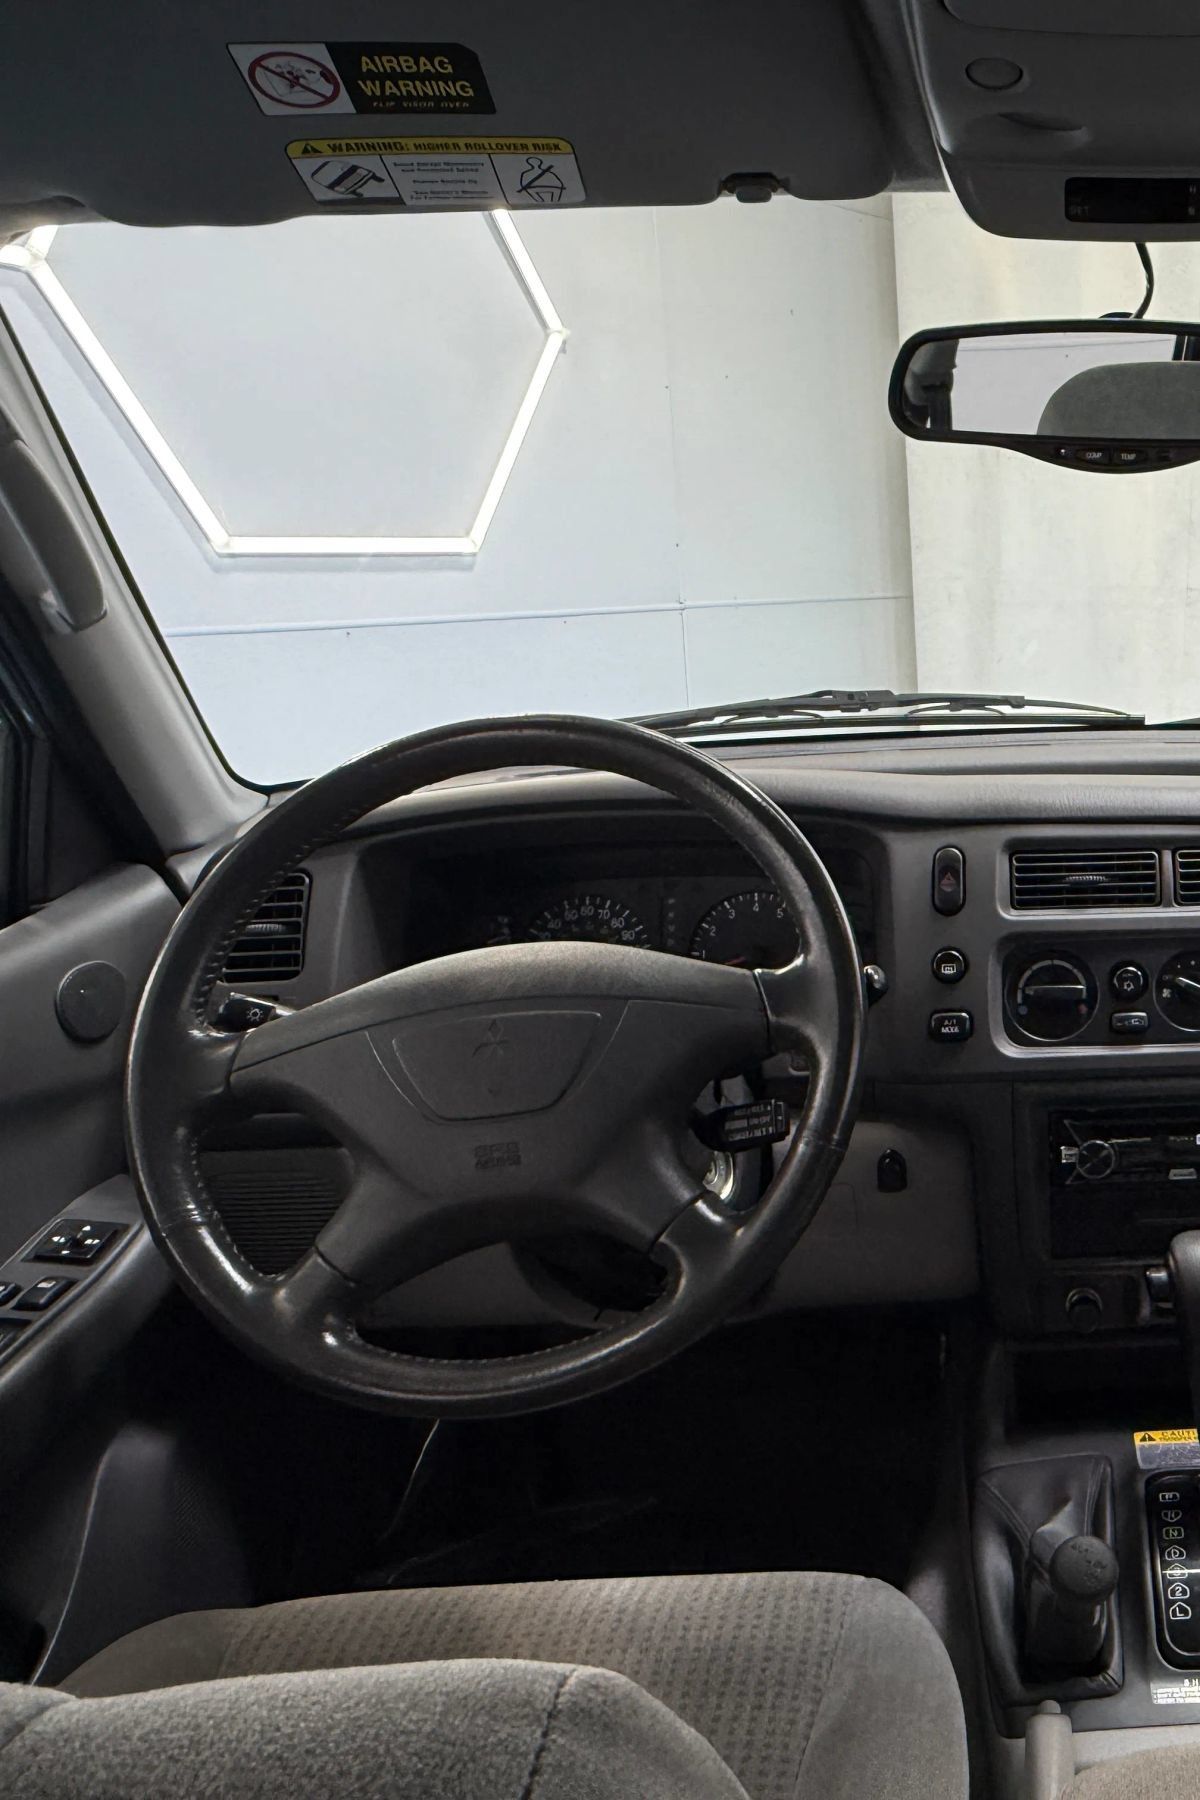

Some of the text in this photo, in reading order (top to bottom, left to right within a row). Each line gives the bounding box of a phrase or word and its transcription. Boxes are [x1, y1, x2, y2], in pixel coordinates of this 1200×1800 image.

[360, 55, 453, 73] AIRBAG
[357, 79, 474, 97] WARNING
[464, 142, 529, 152] ROLLOVER
[532, 142, 562, 152] RISK
[752, 902, 760, 912] 4
[597, 908, 611, 920] 70
[728, 908, 736, 919] 3
[709, 925, 717, 937] 2
[1161, 1429, 1195, 1437] CAUTI
[1175, 1586, 1183, 1597] 2
[1176, 1606, 1184, 1617] L
